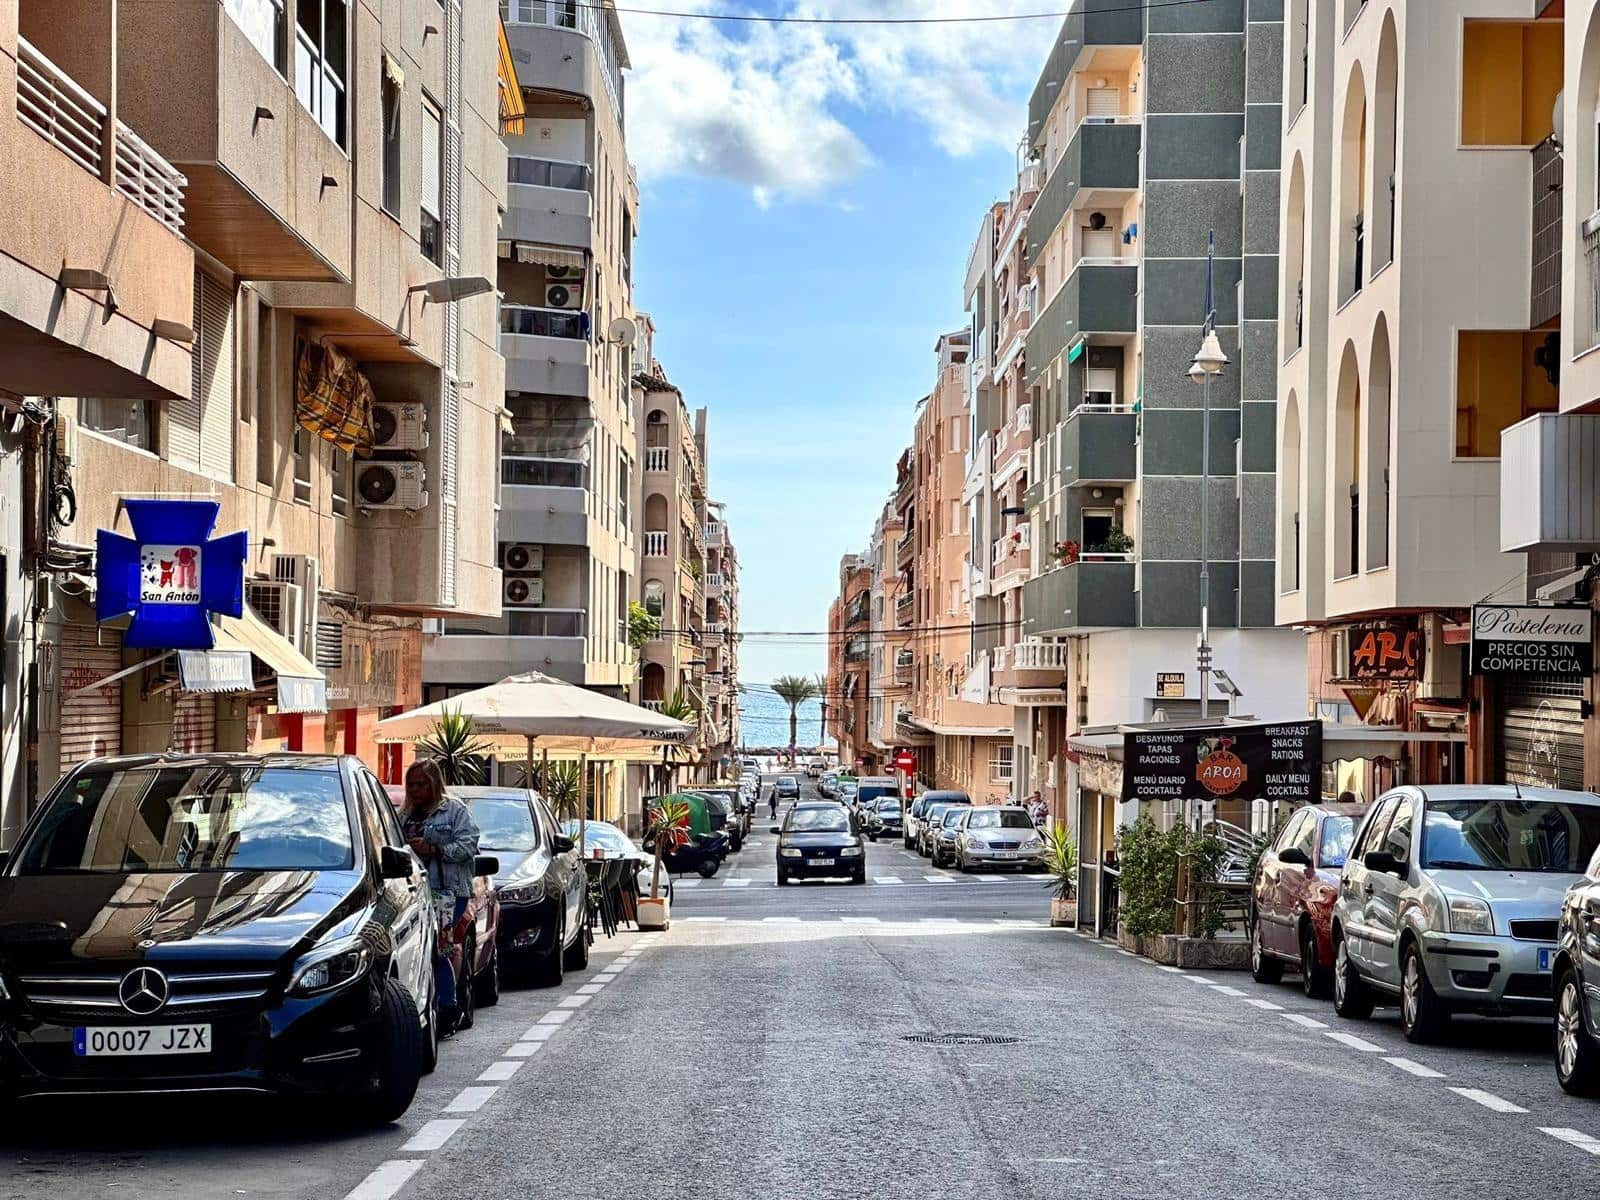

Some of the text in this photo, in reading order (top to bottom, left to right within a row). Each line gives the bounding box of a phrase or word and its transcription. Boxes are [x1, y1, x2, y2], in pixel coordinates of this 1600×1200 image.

[141, 591, 200, 602] San Antón
[1488, 643, 1575, 657] PRECIOS SIN
[1480, 657, 1582, 672] COMPETENCIA
[649, 728, 686, 742] AMBAR
[1265, 726, 1310, 736] BREAKFAST
[1135, 735, 1184, 743] DESAYUNOS
[1271, 738, 1303, 748] SNACKS
[1147, 745, 1173, 754] TAPAS
[1139, 755, 1181, 764] RACIONES
[1271, 750, 1304, 760] RATIONS
[1203, 765, 1241, 778] AROA
[1158, 776, 1186, 784] DIARIO
[1265, 774, 1310, 784] DAILY MENU
[1137, 786, 1182, 795] COCKTAILS
[1267, 786, 1309, 796] COCKTAILS
[92, 1030, 151, 1052] 0007
[162, 1027, 206, 1050] JZX
